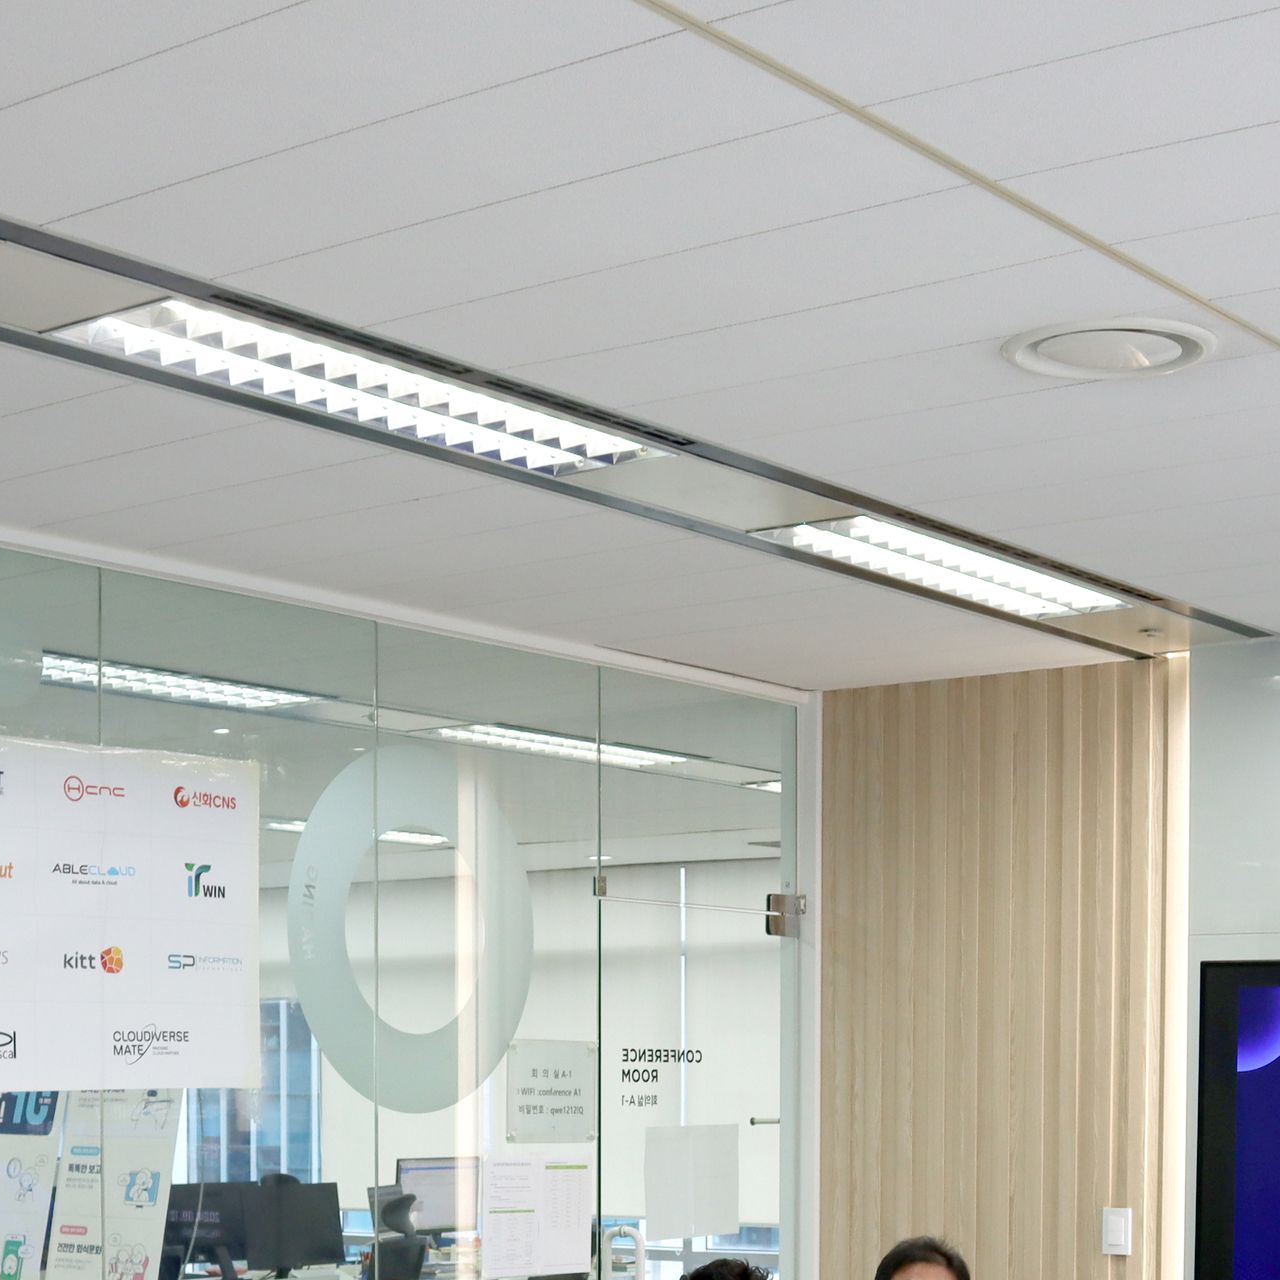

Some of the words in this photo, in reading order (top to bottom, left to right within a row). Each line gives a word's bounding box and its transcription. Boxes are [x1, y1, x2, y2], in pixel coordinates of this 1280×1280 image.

[192, 792, 236, 809] 신화CNS
[203, 884, 225, 898] WIN
[63, 952, 96, 969] kitt
[113, 1031, 189, 1042] CLOUDIVERSE
[113, 1045, 143, 1056] MATE
